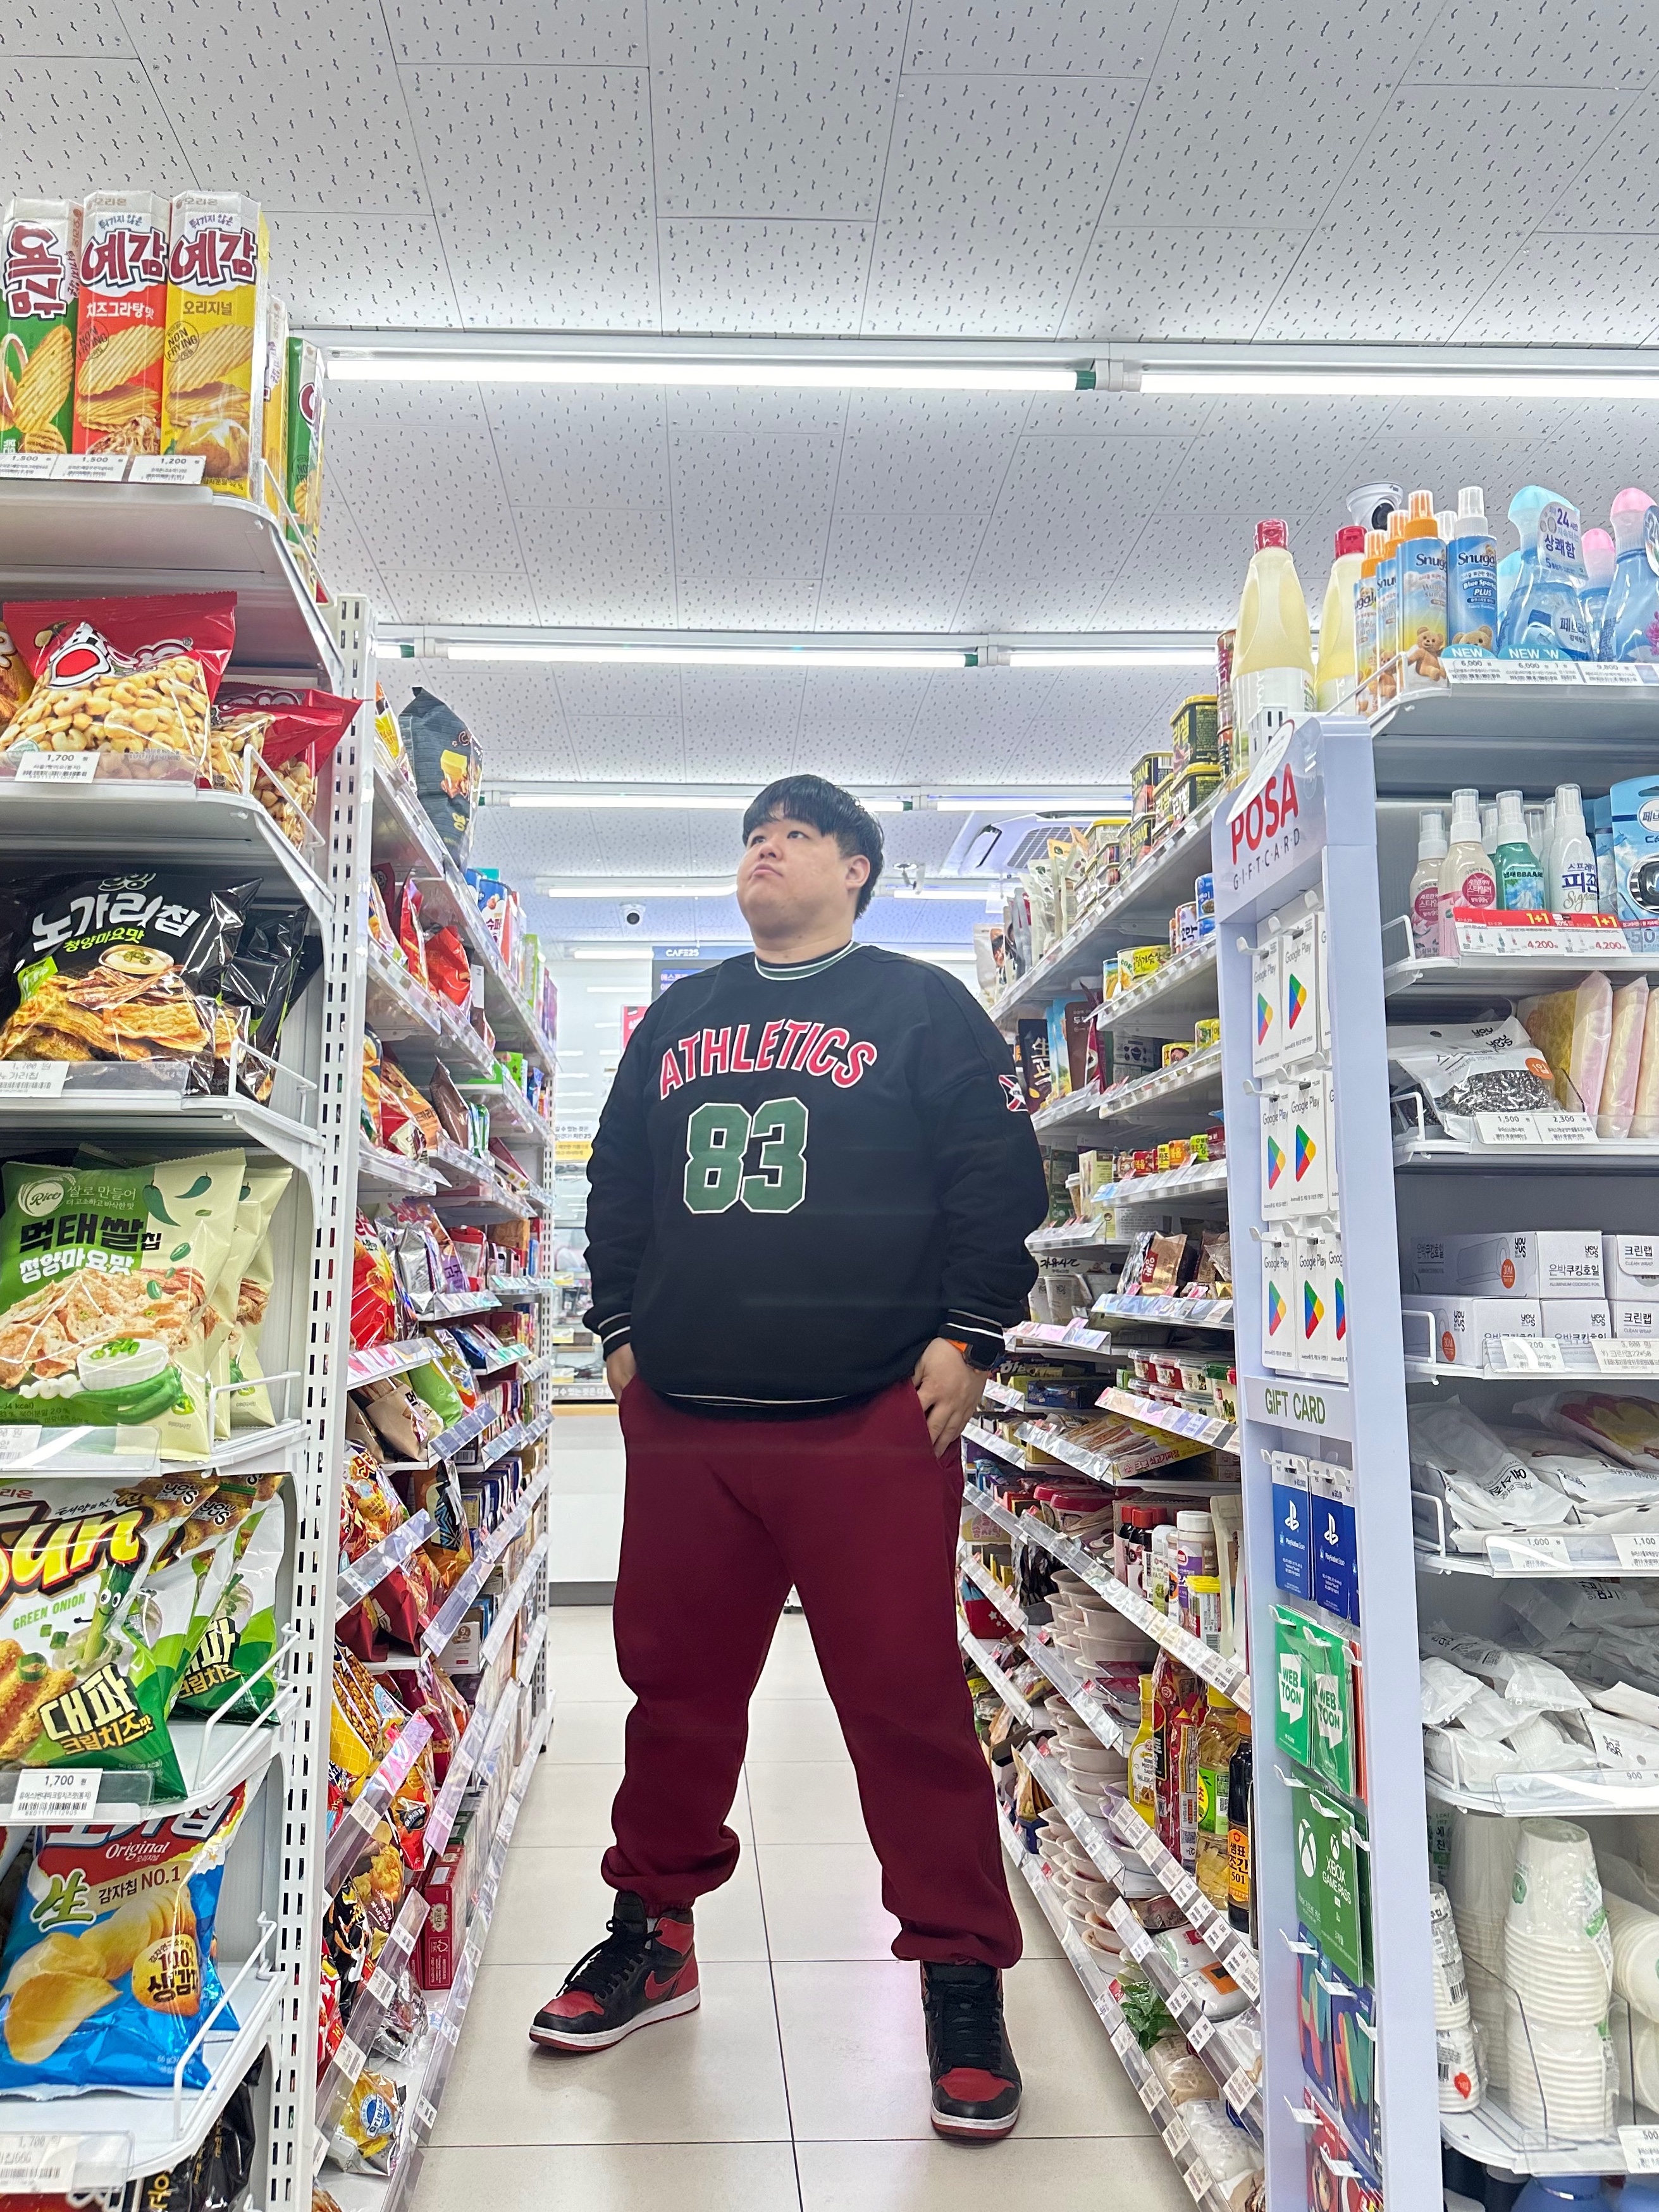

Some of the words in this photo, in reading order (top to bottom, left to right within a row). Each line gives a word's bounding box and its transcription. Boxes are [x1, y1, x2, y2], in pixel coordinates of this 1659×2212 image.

[80, 228, 168, 282] 예감
[170, 228, 257, 283] 예감
[86, 300, 155, 320] 치즈그라탕맛
[182, 300, 233, 317] 오리지널
[166, 333, 199, 361] FRYING
[168, 327, 188, 347] NON
[1557, 507, 1570, 529] 24
[1544, 533, 1576, 560] 상쾌함
[1463, 579, 1478, 590] Blue
[1474, 588, 1493, 597] PLUS
[1451, 648, 1483, 658] NEW
[1508, 648, 1540, 659] NEW
[1231, 762, 1300, 867] POSA
[32, 892, 201, 952] 노가리칩
[1526, 913, 1550, 925] 1+1
[1592, 915, 1619, 929] 1+1
[63, 926, 145, 953] 청양마요맛
[1527, 940, 1554, 949] 4,200
[1594, 941, 1622, 951] 4,200
[665, 949, 700, 957] CAFE25
[1285, 948, 1302, 965] Google
[1302, 942, 1312, 956] Play
[659, 1018, 878, 1101] ATHLETICS
[1292, 1099, 1309, 1114] Google
[1309, 1095, 1321, 1111] Play
[1498, 1115, 1520, 1123] 1,500
[1552, 1115, 1575, 1123] 2,300
[684, 1096, 809, 1214] 83
[67, 1185, 95, 1198] 쌀로
[97, 1185, 137, 1201] 만들어
[20, 1213, 163, 1254] 먹태쌀칩
[1624, 1245, 1653, 1257] 크린랩
[20, 1247, 135, 1284] 청양마요맛
[1299, 1254, 1316, 1271] Google
[1317, 1254, 1328, 1270] Play
[1549, 1263, 1600, 1276] 은박쿠킹호일
[1624, 1313, 1652, 1325] 크린랩
[1265, 1387, 1289, 1418] GIFT
[1293, 1392, 1326, 1424] CARD
[0, 1488, 34, 1499] 리온
[1527, 1538, 1550, 1547] 1,000
[1633, 1538, 1656, 1546] 1,100
[13, 1605, 48, 1631] GREEN
[52, 1591, 87, 1616] ONION
[1283, 1667, 1298, 1688] WEB
[40, 1664, 131, 1740] 대파
[1281, 1680, 1302, 1705] TOON
[1318, 1703, 1340, 1730] TOON
[59, 1712, 154, 1754] 크림치즈맛
[45, 1775, 75, 1787] 1,700
[1625, 1772, 1643, 1780] 900
[105, 1841, 171, 1861] Original
[1230, 1843, 1247, 1858] 샘표
[1231, 1873, 1246, 1885] 501
[1326, 1855, 1347, 1886] XBOX
[99, 1878, 138, 1905] 감자칩
[141, 1865, 181, 1891] NO.1
[32, 1869, 96, 1931] 生
